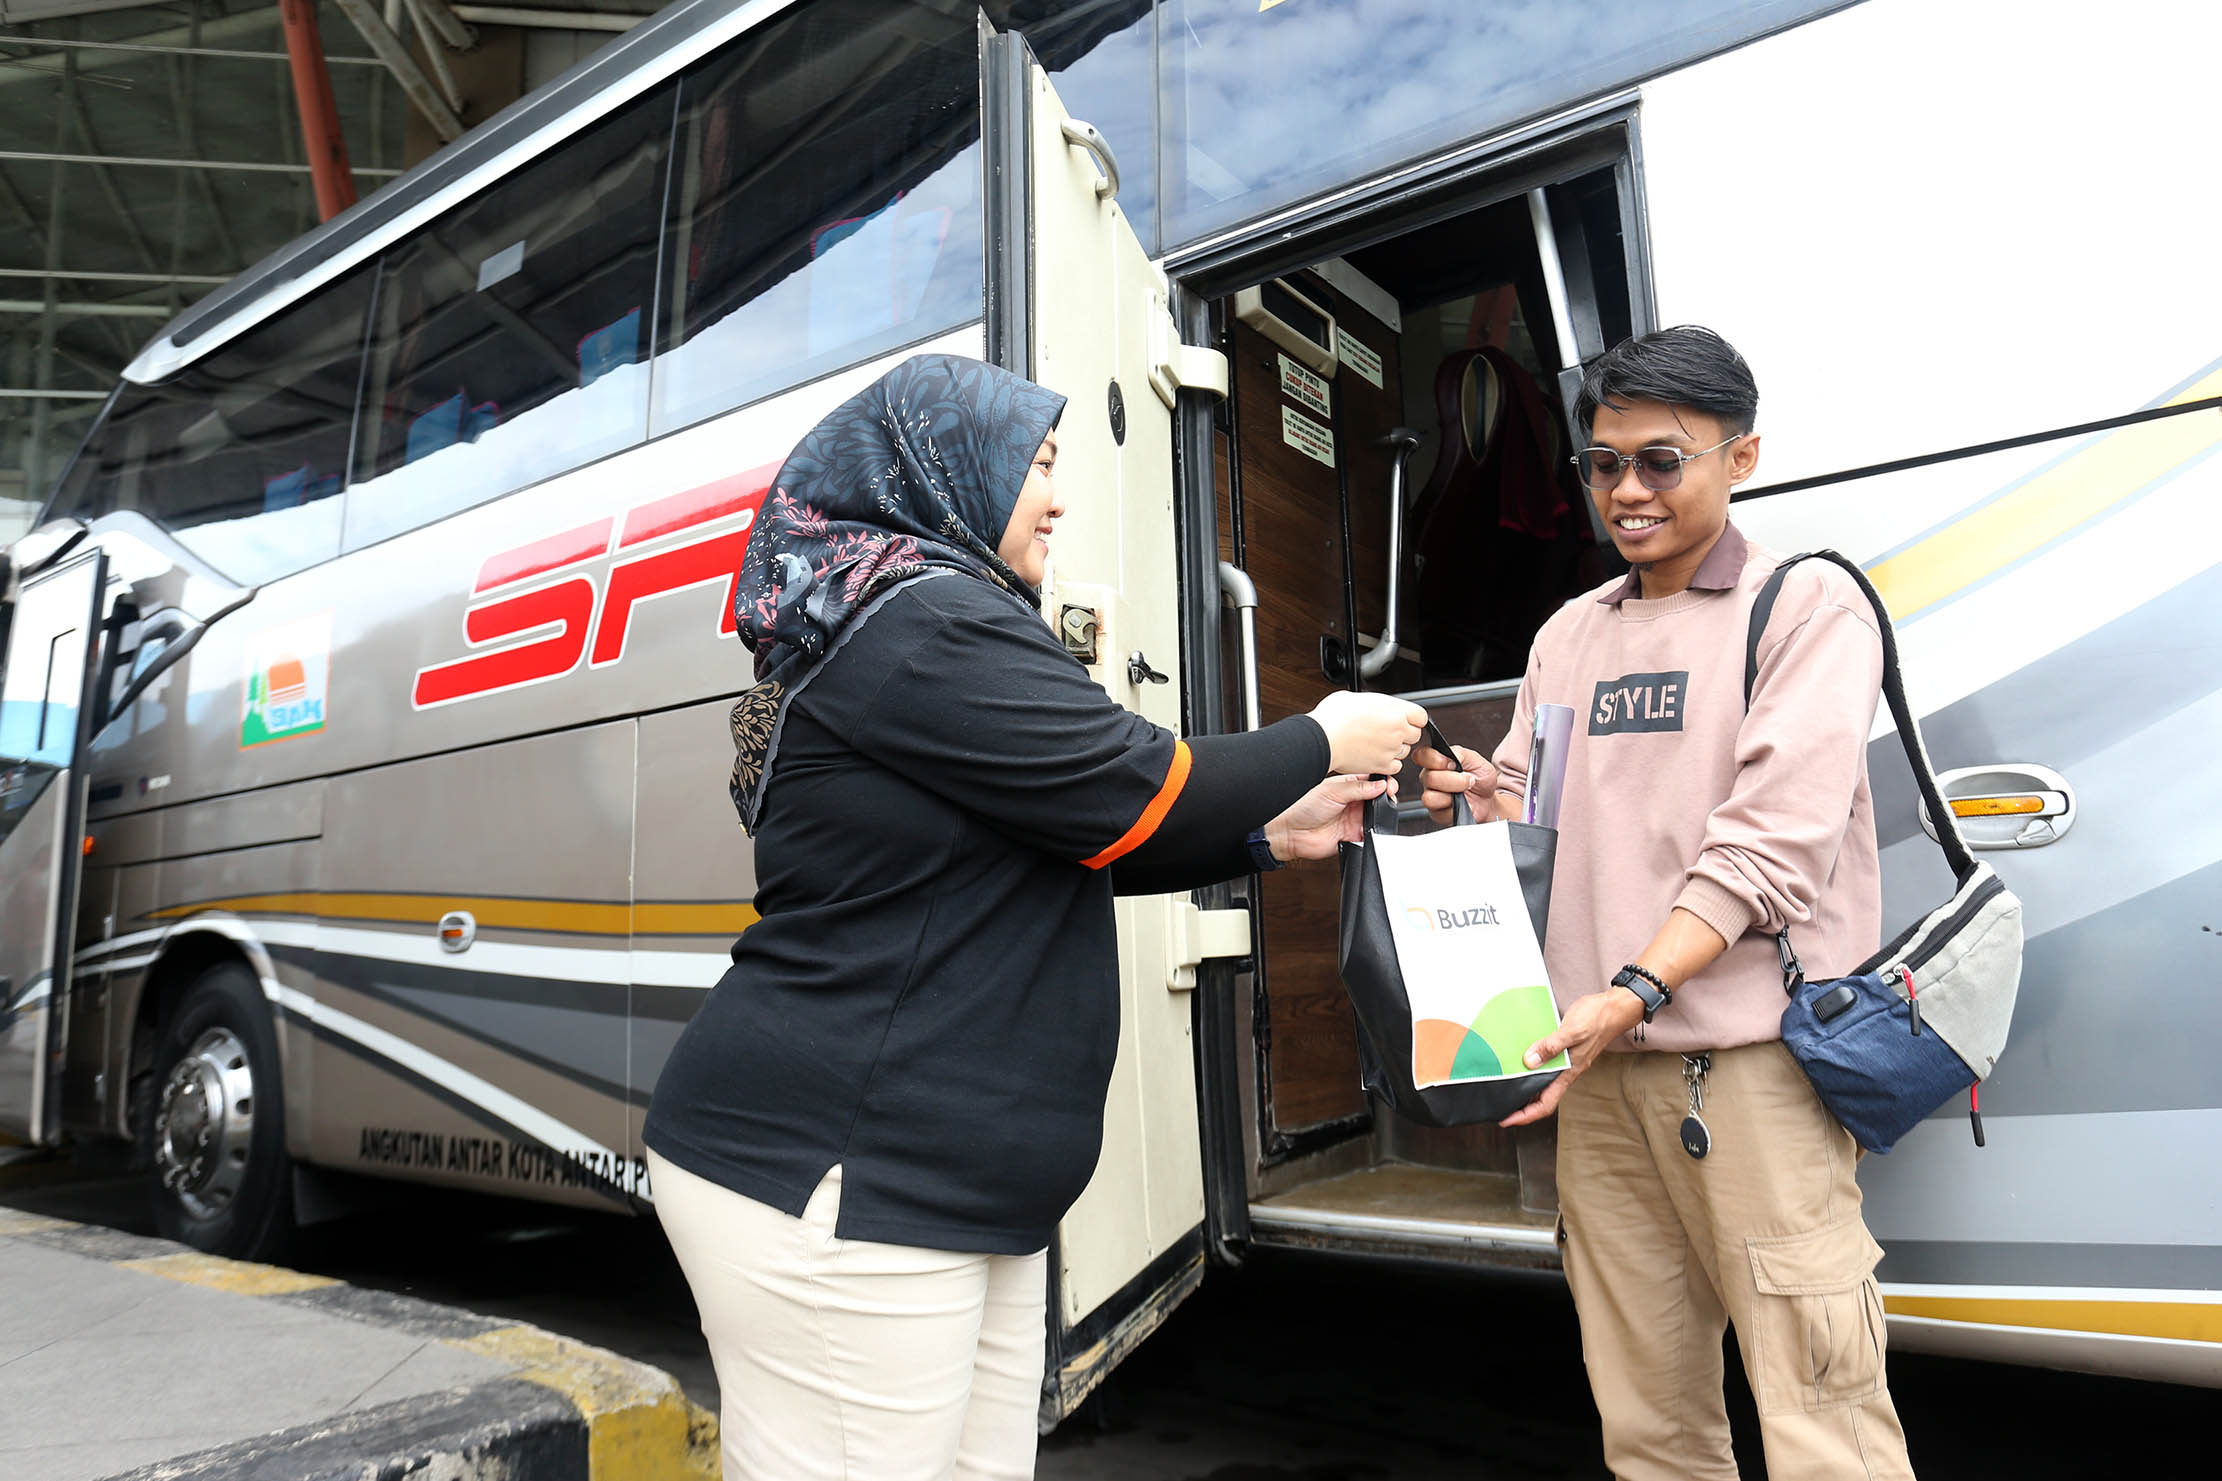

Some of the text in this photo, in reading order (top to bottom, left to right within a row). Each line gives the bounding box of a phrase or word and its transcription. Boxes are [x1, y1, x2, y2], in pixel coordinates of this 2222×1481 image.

[1595, 684, 1677, 724] STYLE
[1437, 902, 1500, 929] Buzzit
[360, 1127, 443, 1168] ANGKUTAN
[447, 1135, 503, 1178] ANTAR
[509, 1141, 556, 1185] KOTA
[560, 1147, 626, 1195] ANTAR
